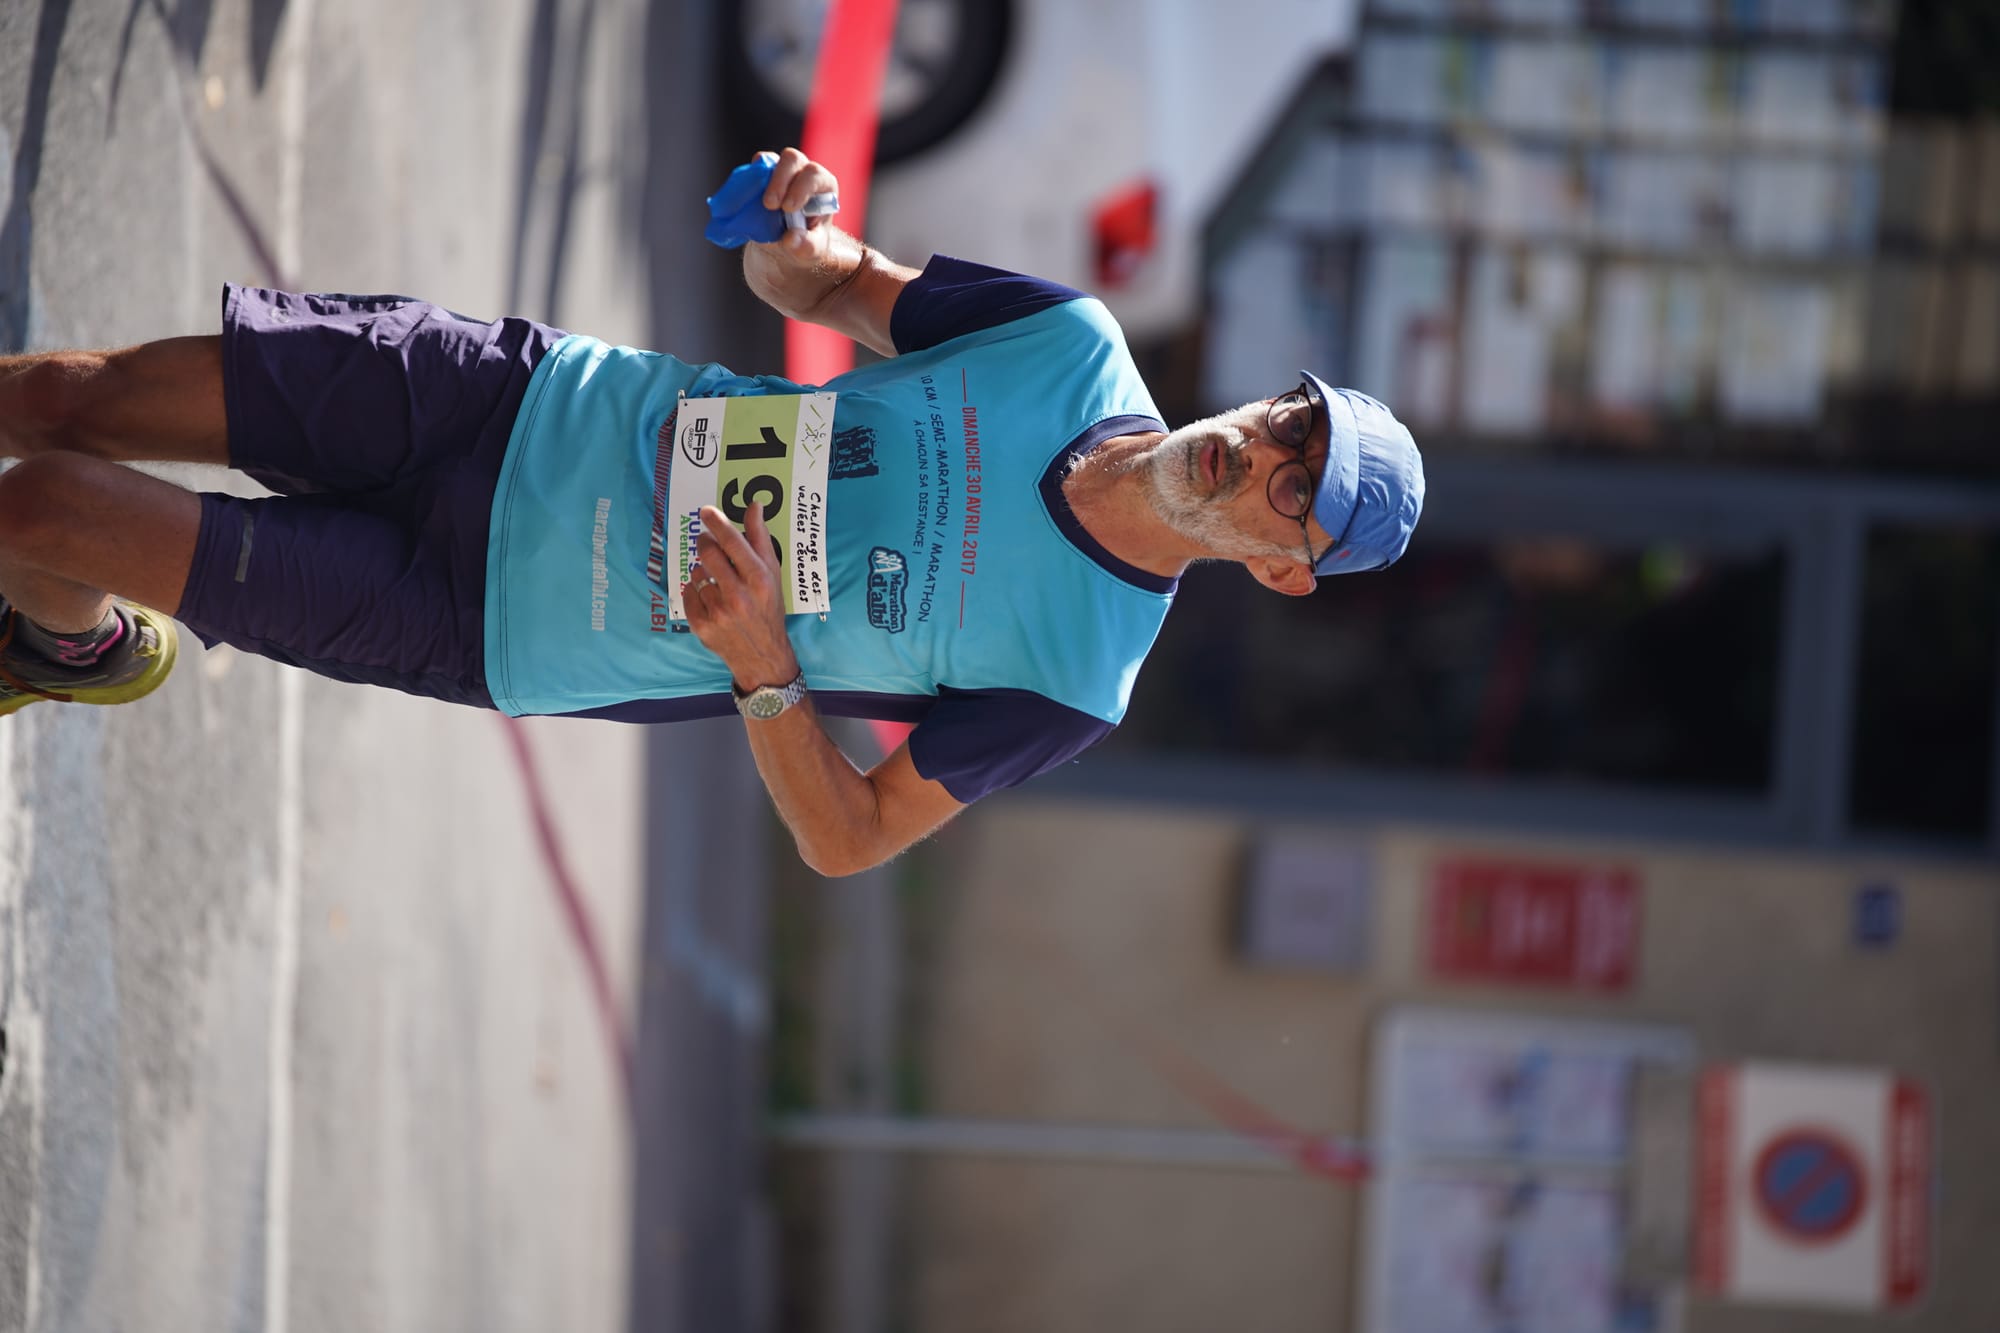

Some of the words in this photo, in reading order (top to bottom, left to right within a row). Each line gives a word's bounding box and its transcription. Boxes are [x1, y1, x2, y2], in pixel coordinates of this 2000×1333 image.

[920, 375, 933, 385] 10
[923, 386, 937, 403] KM
[695, 417, 708, 461] BFP
[915, 428, 928, 470] CHACUN
[962, 406, 981, 473] DIMANCHE
[919, 472, 928, 489] SA
[930, 413, 949, 526] SEMI-MARATHON
[966, 475, 981, 494] 30
[722, 426, 787, 568] 19
[796, 485, 806, 534] vallées
[912, 491, 929, 548] DISTANCE
[963, 495, 981, 537] AVRIL
[806, 491, 822, 562] Challenge
[591, 497, 612, 631] marathondalbi.com
[680, 514, 692, 597] Aventure
[797, 541, 808, 603] cévenoles
[960, 539, 977, 576] 2017
[811, 571, 822, 594] des
[870, 574, 889, 628] d'albi
[889, 572, 902, 629] Marathon
[917, 542, 943, 623] MARATHON
[649, 589, 667, 632] ALBI
